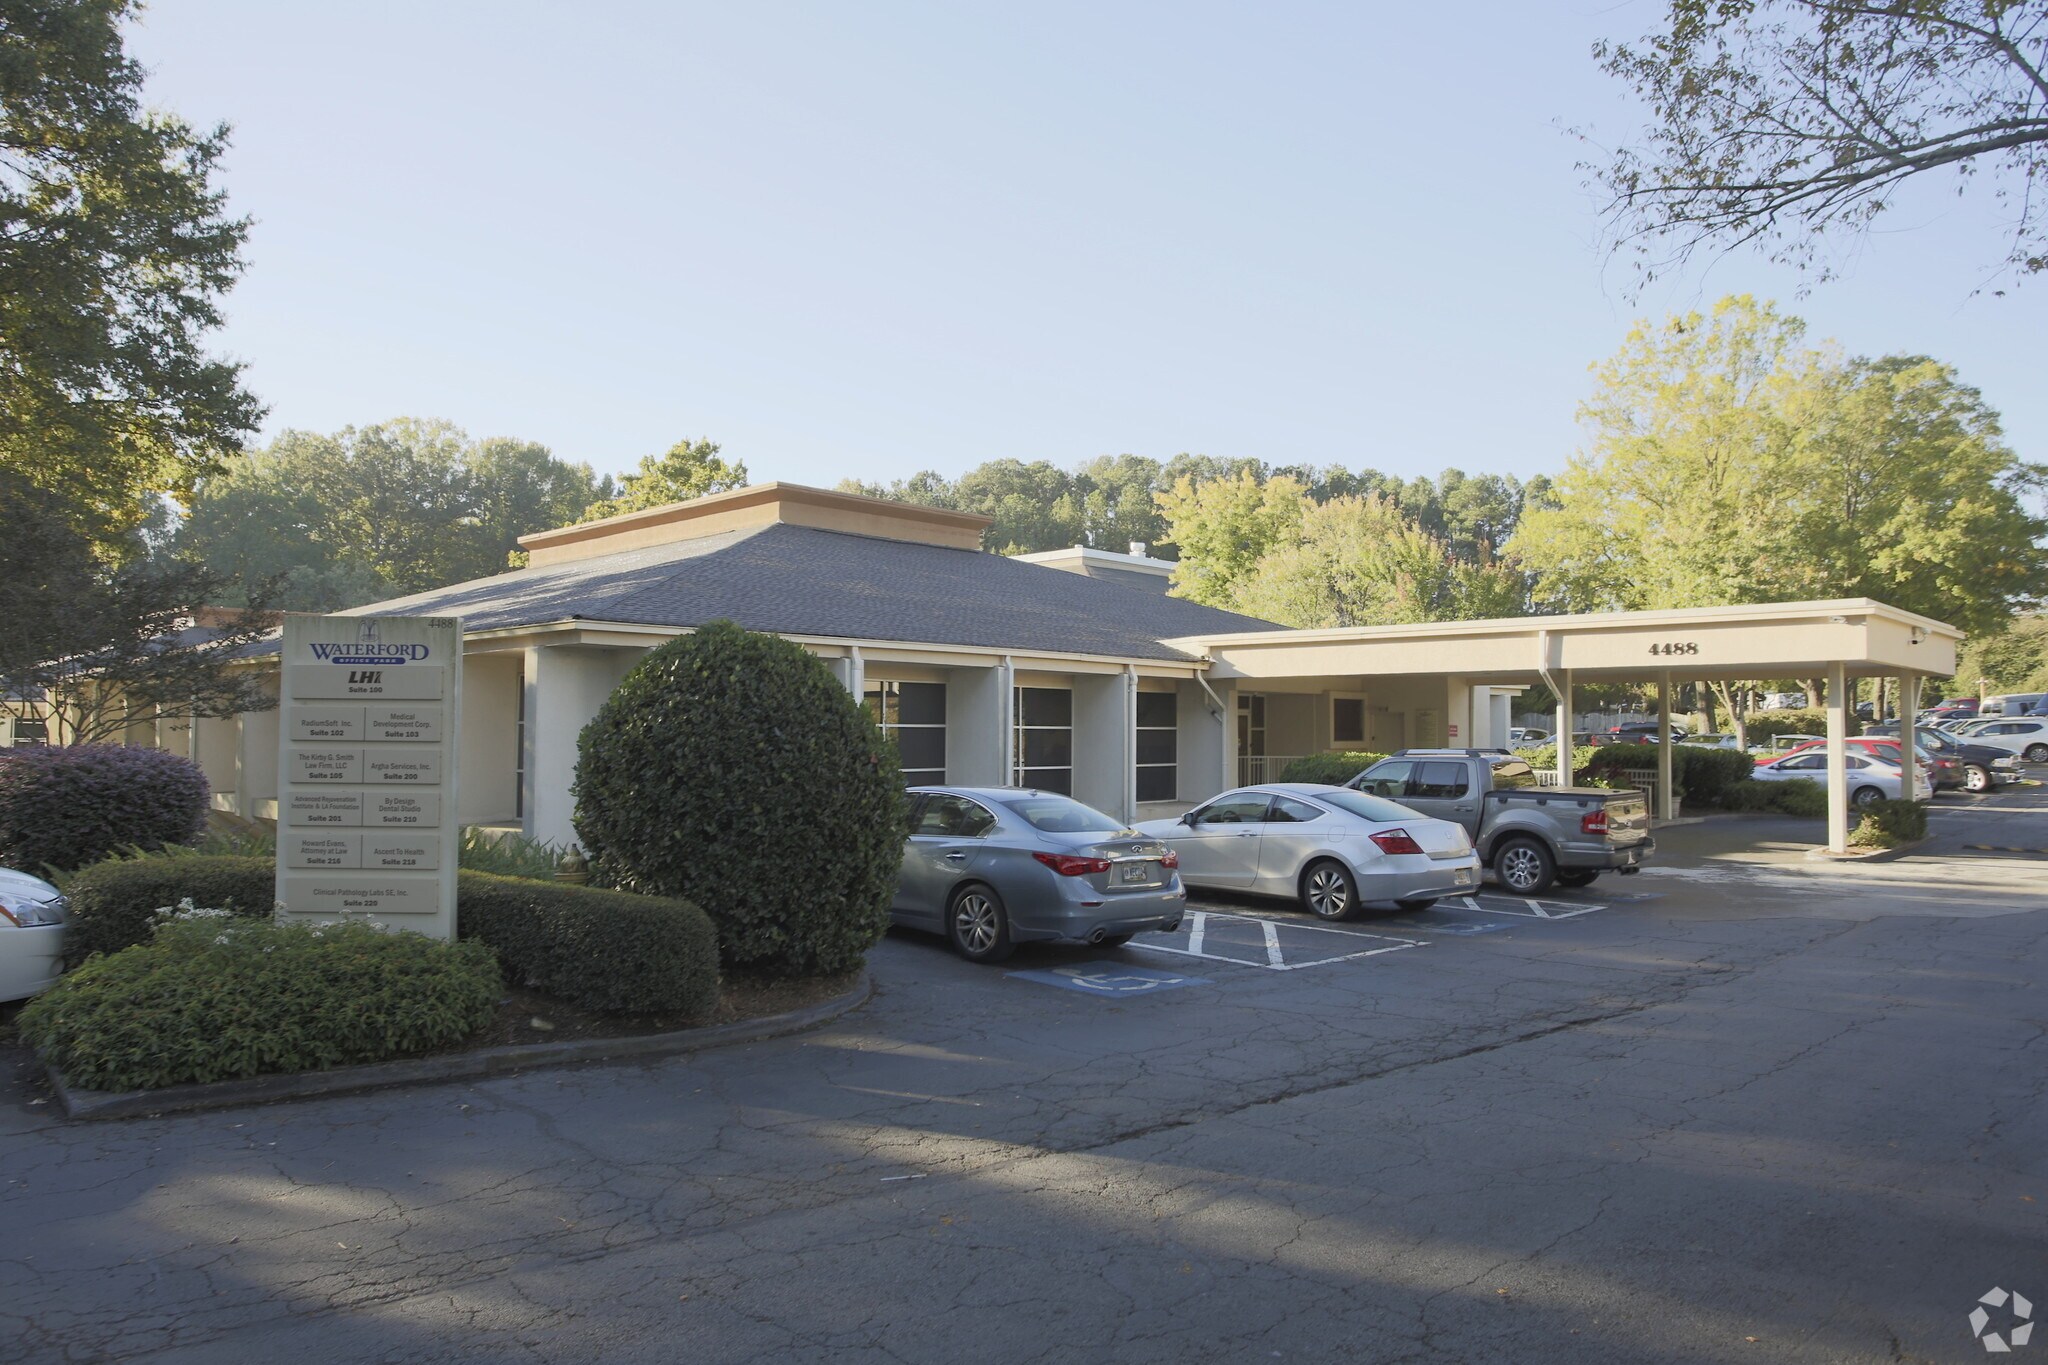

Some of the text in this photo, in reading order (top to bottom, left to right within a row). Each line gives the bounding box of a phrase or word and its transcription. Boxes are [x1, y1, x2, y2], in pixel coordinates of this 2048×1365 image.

[428, 619, 454, 629] 4488
[309, 643, 430, 661] WATERFORD
[1648, 642, 1699, 656] 4488
[373, 721, 432, 729] Development Corp.
[311, 754, 327, 762] Kirby
[390, 763, 419, 771] Services,
[393, 798, 416, 806] Design
[404, 848, 425, 856] Health
[313, 888, 336, 896] Clinical
[337, 888, 369, 897] Pathology
[369, 888, 385, 896] Labs
[396, 889, 408, 897] Inc.
